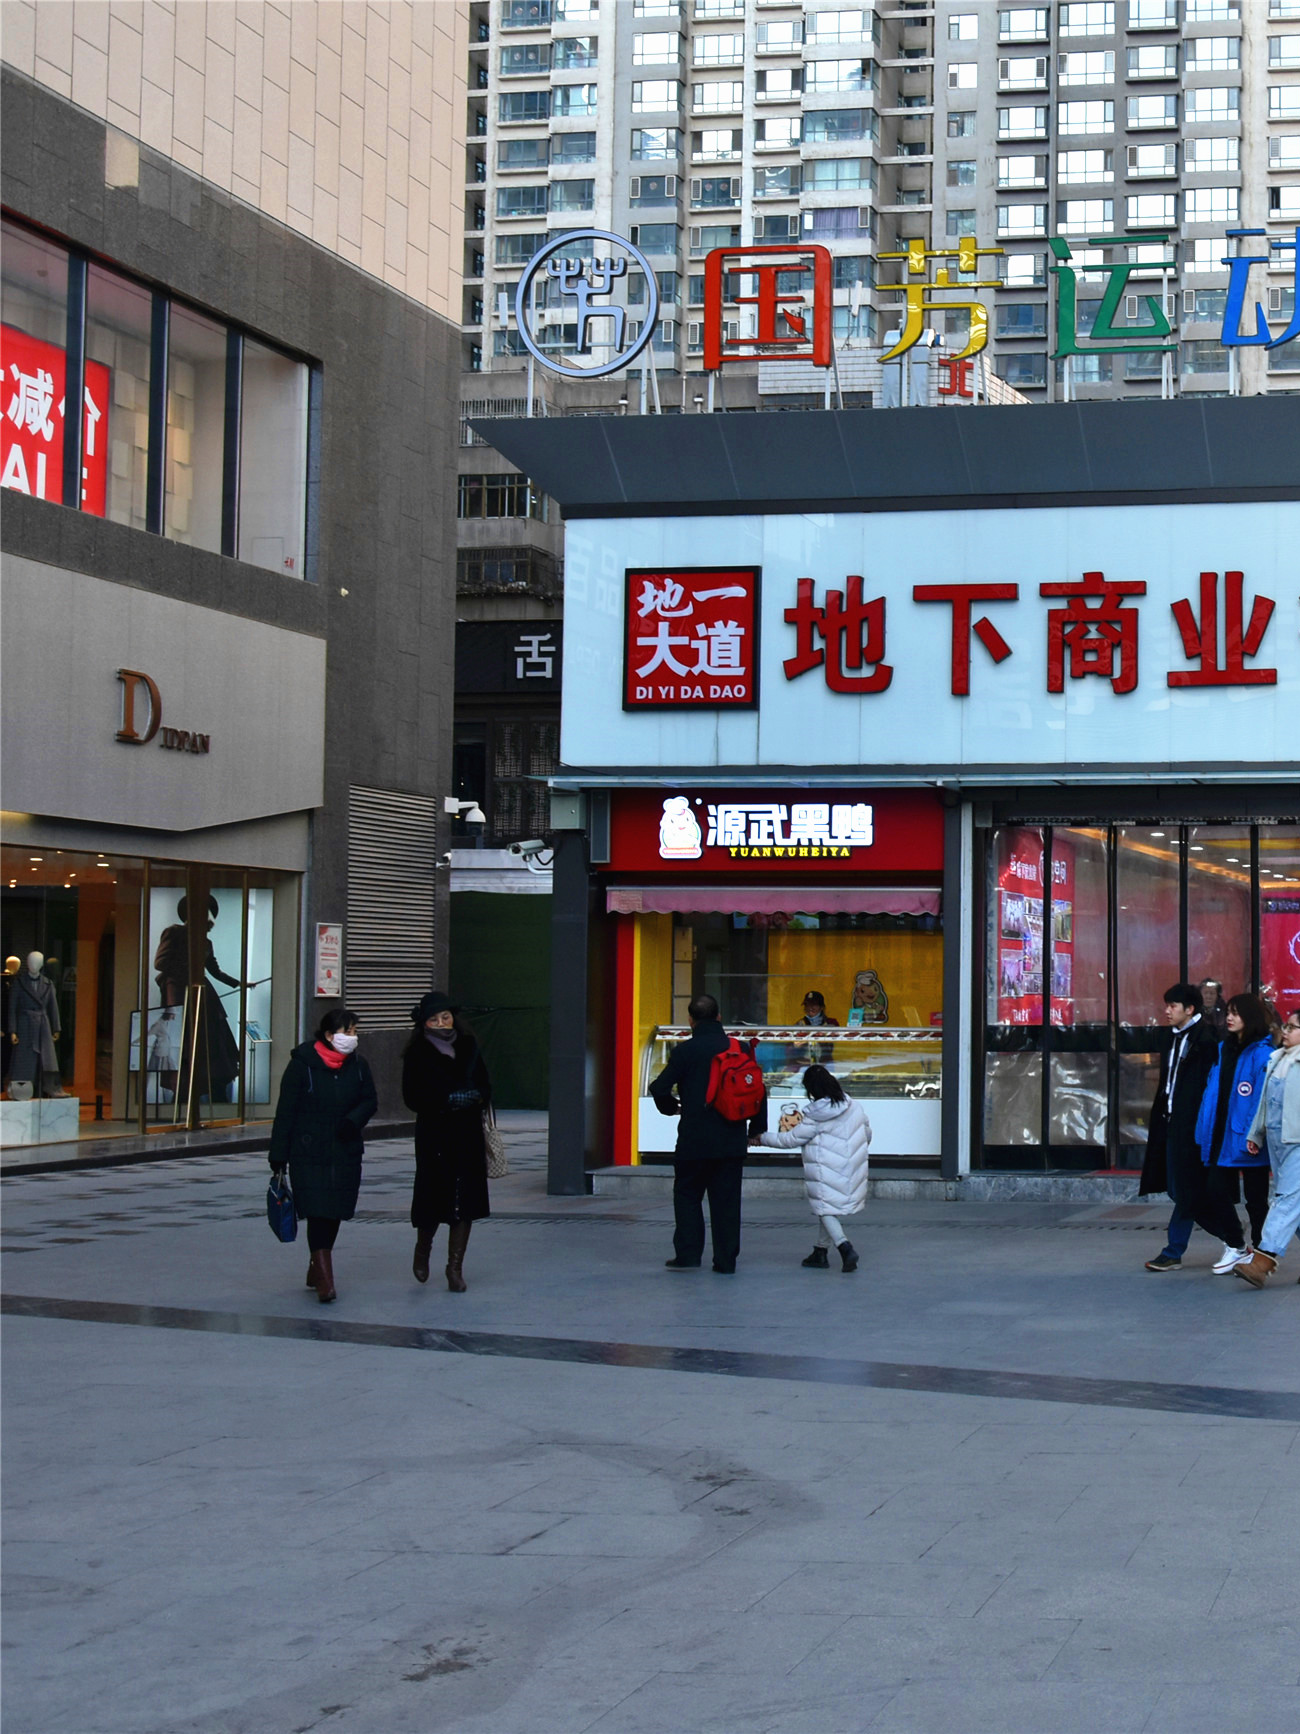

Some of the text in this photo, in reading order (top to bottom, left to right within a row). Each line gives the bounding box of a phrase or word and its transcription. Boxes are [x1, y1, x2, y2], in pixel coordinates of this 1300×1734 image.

[636, 578, 747, 618] 地一
[635, 620, 746, 679] 大道
[635, 684, 746, 699] DI YI DA DAO
[706, 803, 873, 846] 源武黑鸭
[729, 847, 850, 857] YUANWUHEIYA
